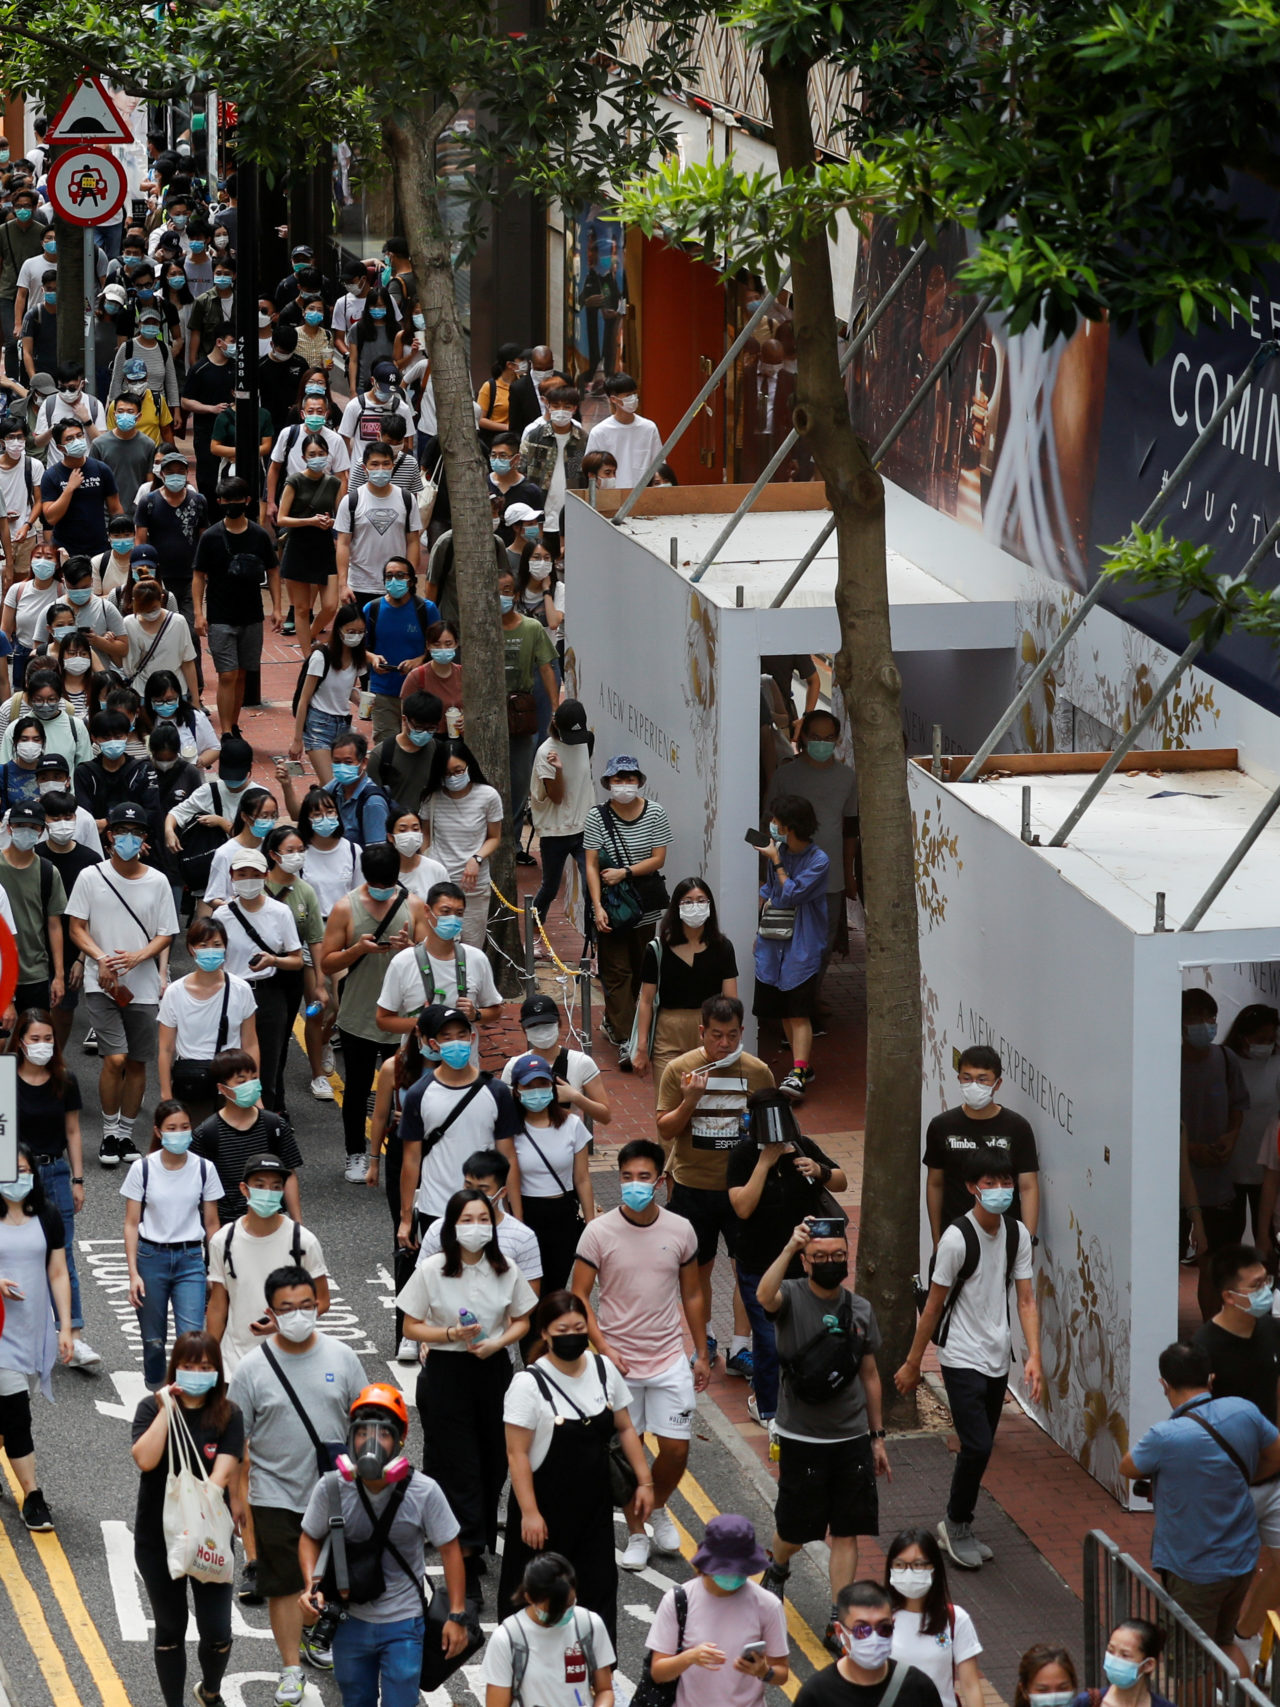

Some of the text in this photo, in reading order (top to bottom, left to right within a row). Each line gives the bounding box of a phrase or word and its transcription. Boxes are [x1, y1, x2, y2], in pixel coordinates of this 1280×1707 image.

[238, 381, 244, 389] A
[608, 686, 625, 723] NEW
[628, 704, 682, 774] EXPERIENCE
[1000, 1036, 1074, 1136] EXPERIENCE
[196, 1544, 225, 1567] Holle
